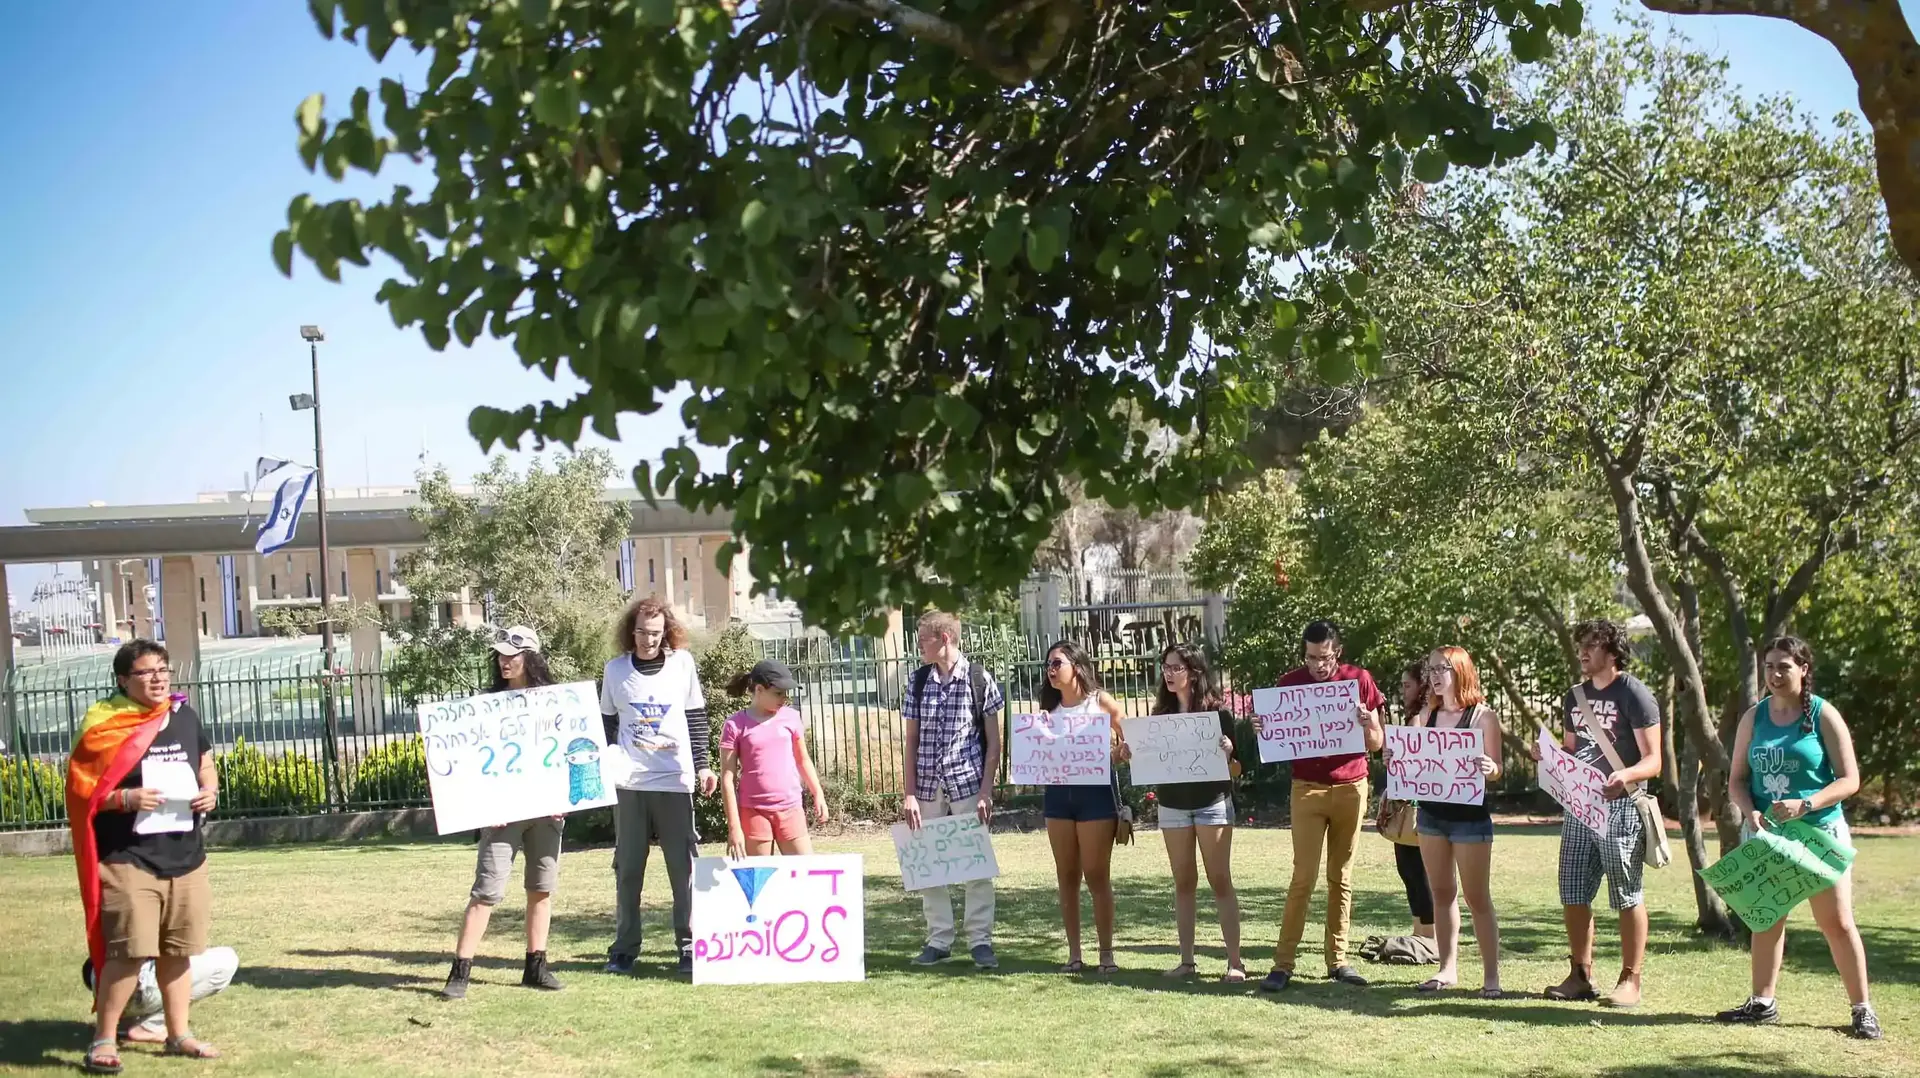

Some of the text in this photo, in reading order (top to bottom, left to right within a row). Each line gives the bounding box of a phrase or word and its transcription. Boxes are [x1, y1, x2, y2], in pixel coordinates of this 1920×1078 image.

[1260, 718, 1354, 741] למען החופש
[1390, 728, 1475, 759] הגוף שלי
[791, 869, 844, 896] די
